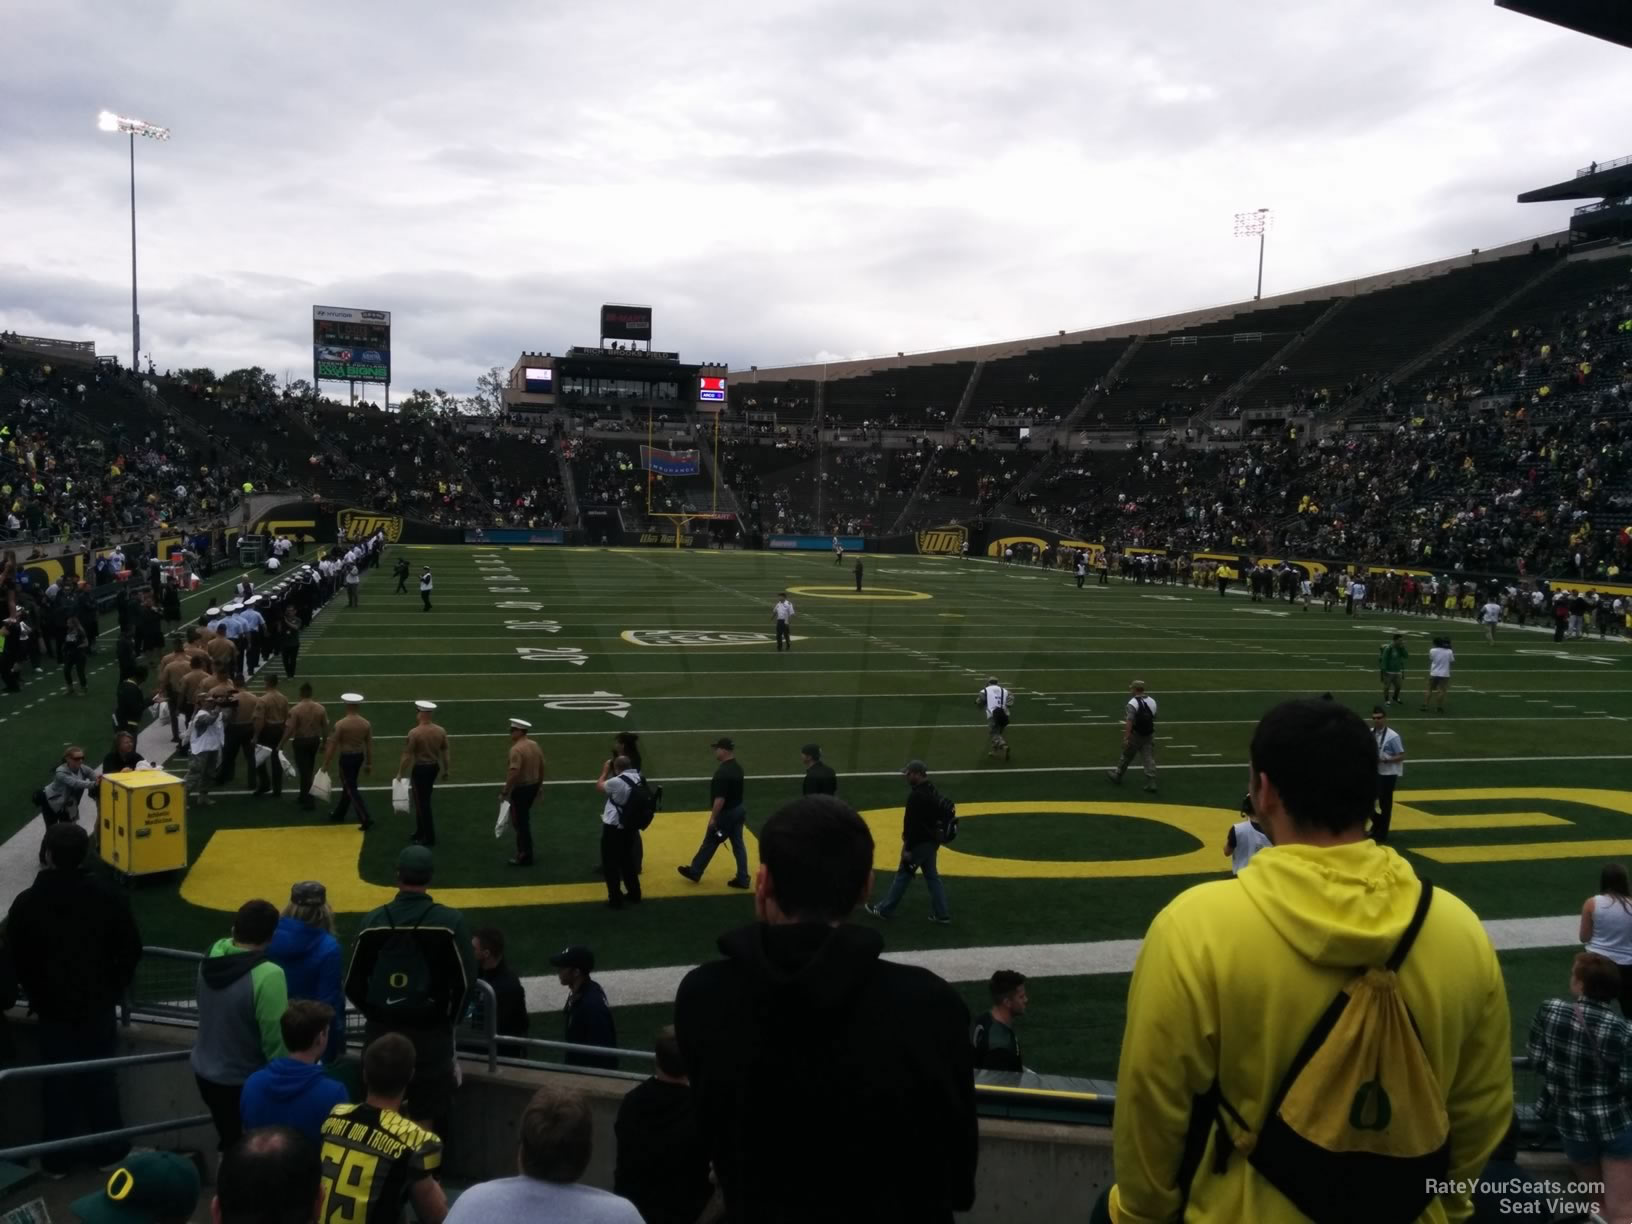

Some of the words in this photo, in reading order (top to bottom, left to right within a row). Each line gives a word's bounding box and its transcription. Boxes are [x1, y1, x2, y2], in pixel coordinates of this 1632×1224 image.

[584, 348, 604, 356] RICH
[608, 349, 643, 358] BROOKS
[646, 352, 668, 360] FIELD
[515, 647, 589, 661] 20
[538, 691, 631, 710] 10
[146, 791, 170, 810] O
[389, 972, 408, 988] O
[347, 1122, 369, 1142] OUR
[366, 1129, 407, 1159] TROOPS
